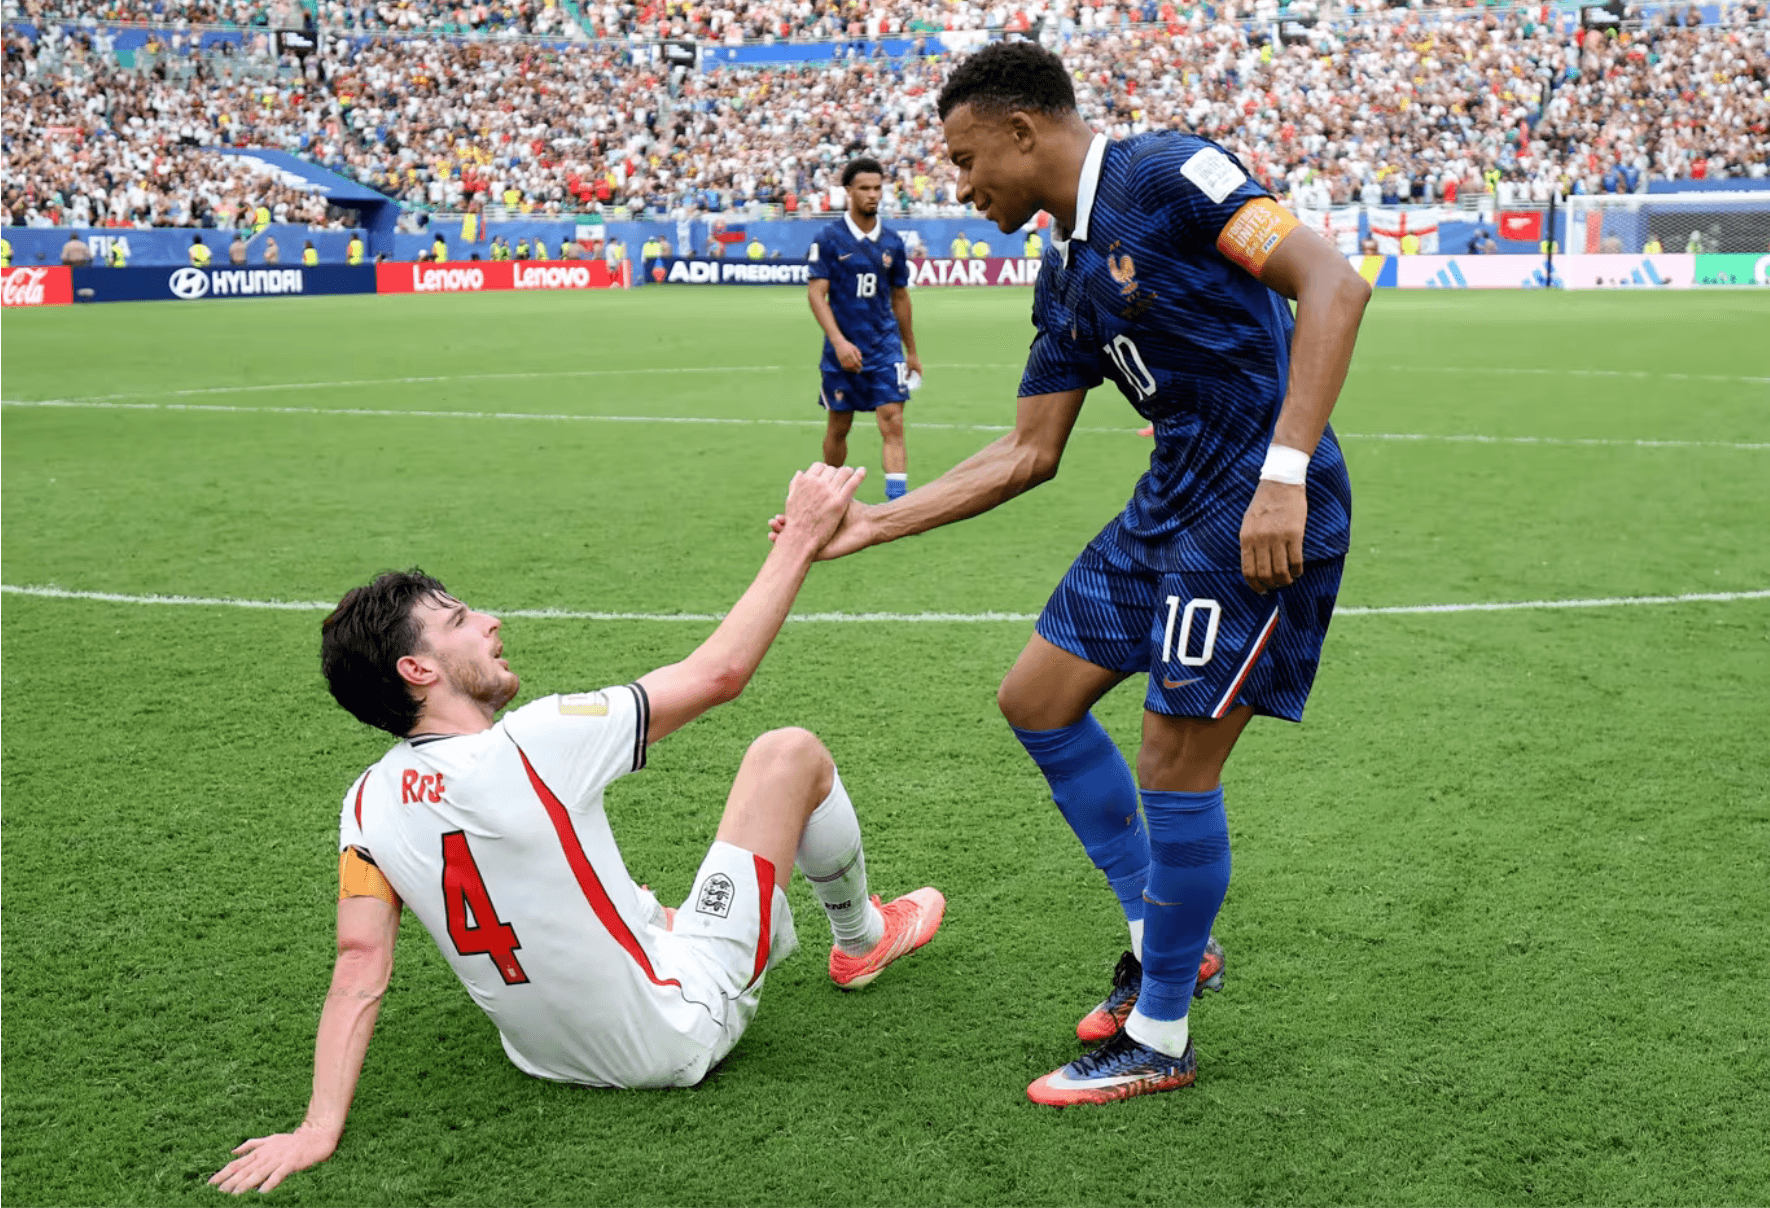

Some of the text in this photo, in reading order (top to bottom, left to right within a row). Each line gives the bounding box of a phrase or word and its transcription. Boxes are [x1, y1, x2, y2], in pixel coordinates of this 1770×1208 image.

[1233, 205, 1272, 248] UNITES
[212, 269, 303, 294] HYUNDAI
[413, 264, 484, 291] Lenovo
[513, 262, 590, 288] Lenovo
[668, 260, 719, 283] ADI
[856, 273, 877, 298] 18
[1103, 334, 1157, 401] 10
[1162, 595, 1221, 666] 10
[441, 829, 531, 986] 4
